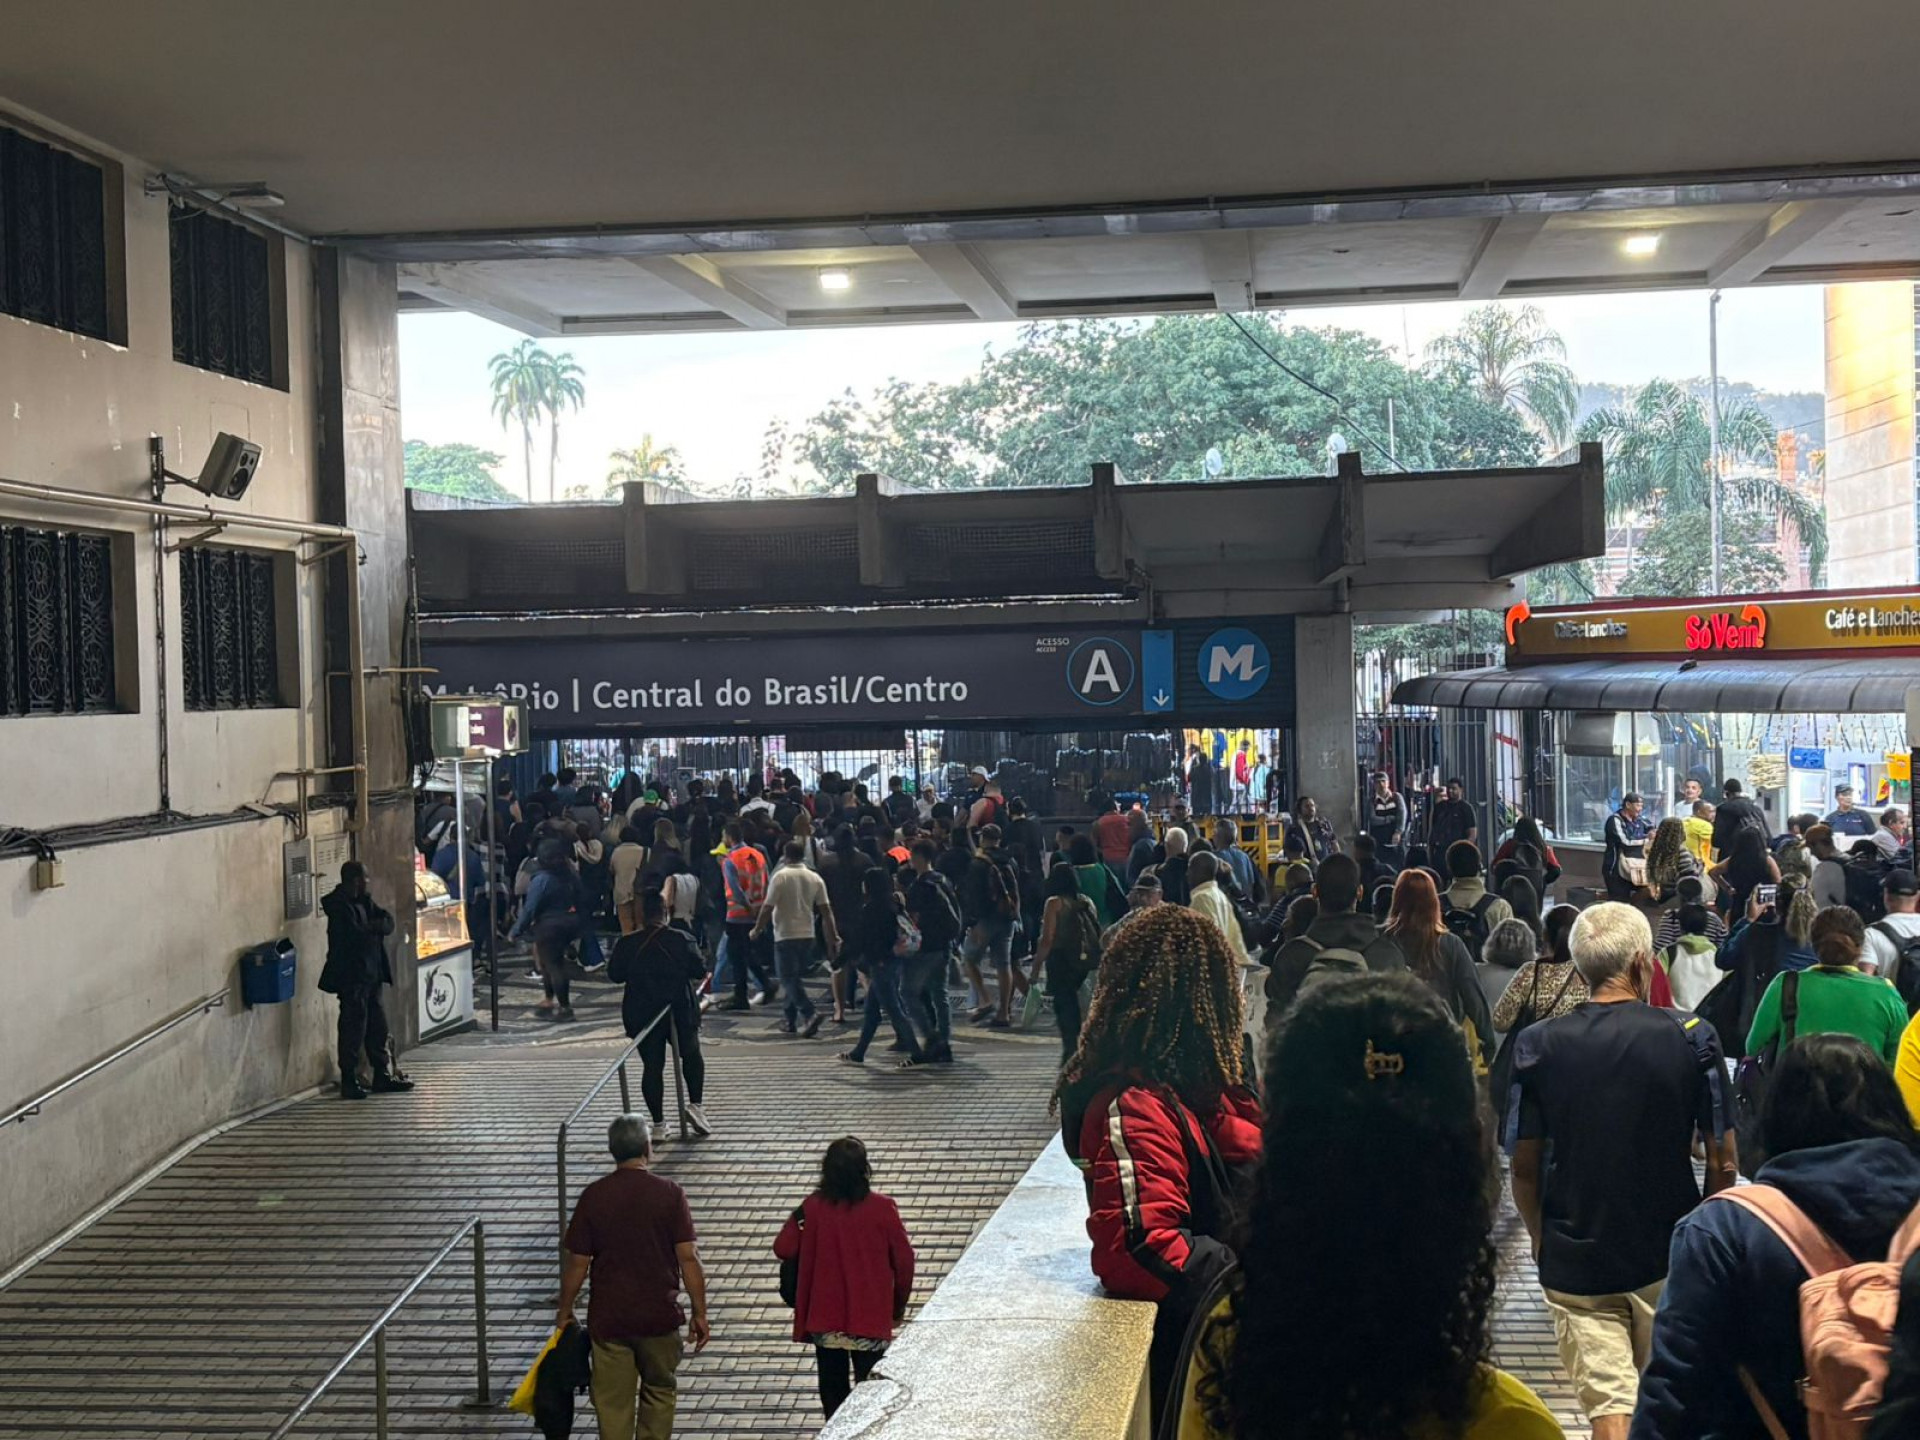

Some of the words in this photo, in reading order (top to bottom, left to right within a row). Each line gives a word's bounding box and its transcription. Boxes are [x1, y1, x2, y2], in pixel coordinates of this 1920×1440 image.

[1825, 607, 1855, 629] Café
[1858, 612, 1867, 628] e
[1036, 637, 1070, 646] ACESSO
[1081, 649, 1121, 693] A
[593, 679, 703, 709] Central
[715, 678, 751, 706] do
[765, 676, 968, 705] Brasil/Centro
